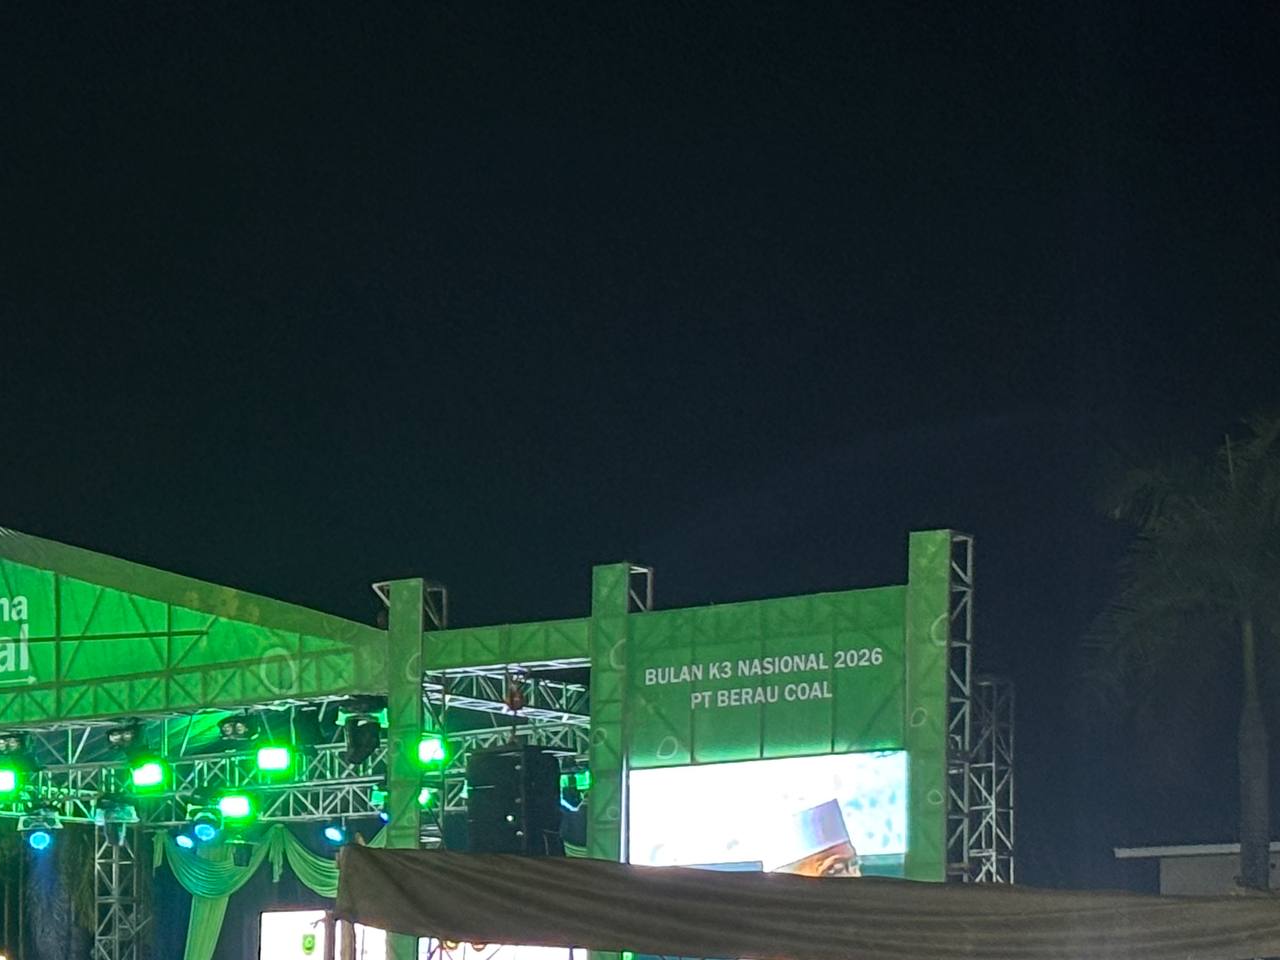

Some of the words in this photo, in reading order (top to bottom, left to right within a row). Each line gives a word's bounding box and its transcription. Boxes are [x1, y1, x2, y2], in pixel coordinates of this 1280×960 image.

[645, 665, 703, 685] BULAN
[709, 661, 731, 679] K3
[738, 653, 829, 677] NASIONAL
[834, 648, 882, 668] 2026
[690, 691, 712, 709] PT
[717, 686, 778, 707] BERAU
[784, 681, 832, 701] COAL
